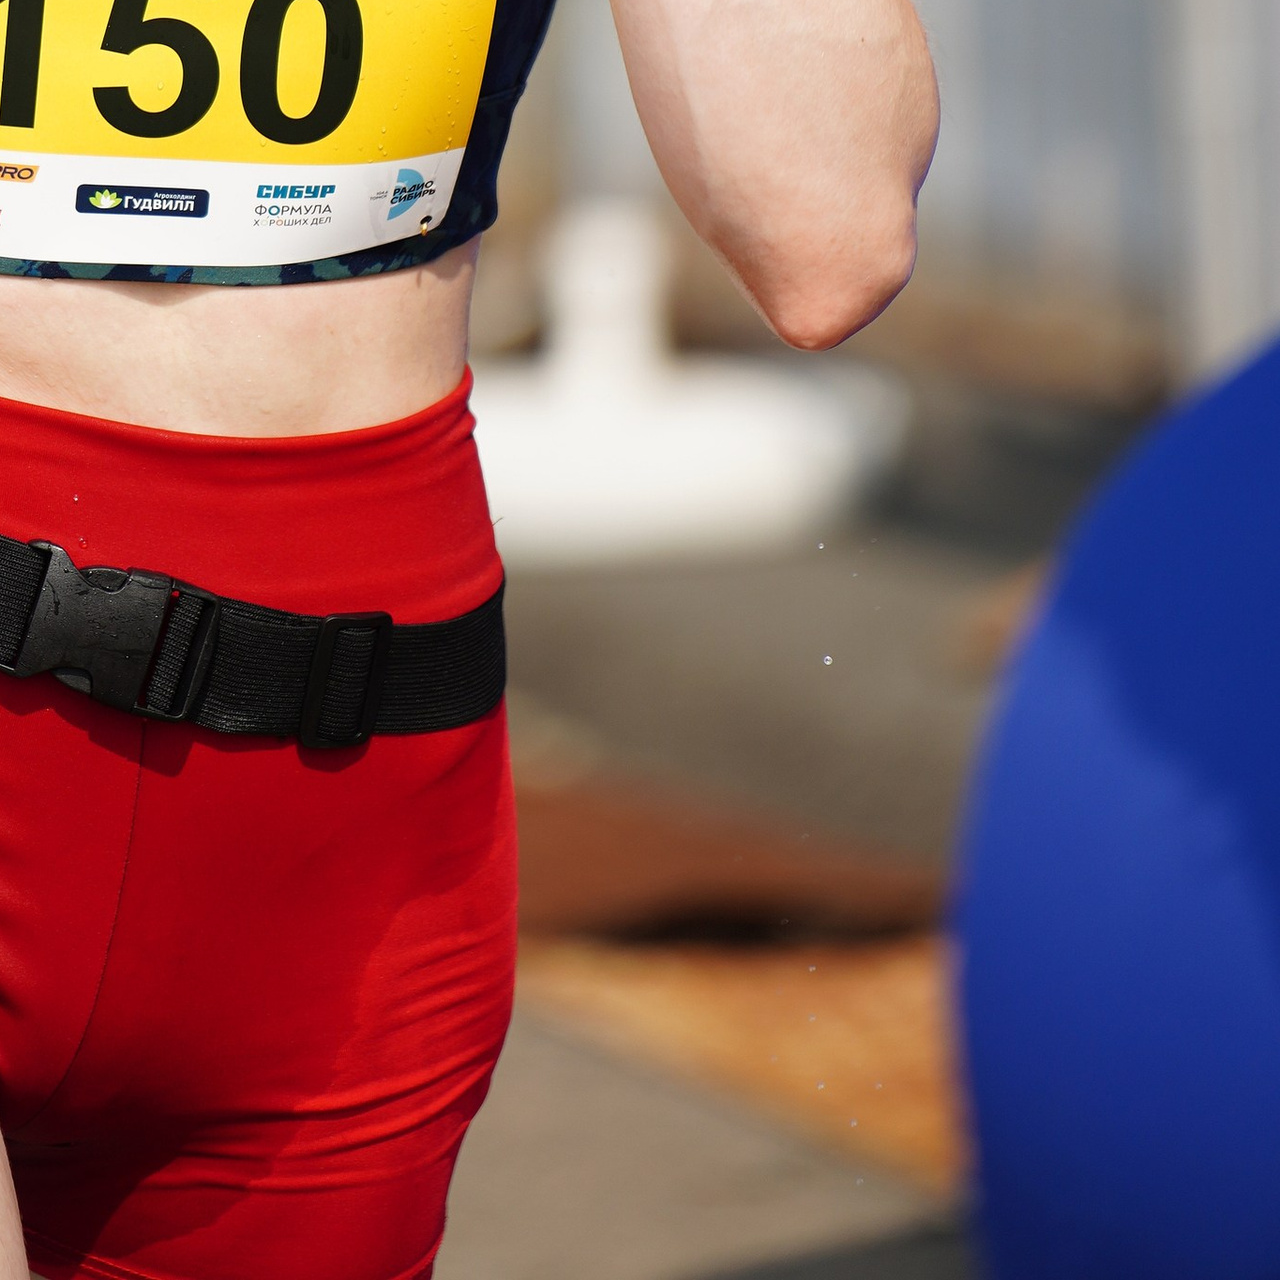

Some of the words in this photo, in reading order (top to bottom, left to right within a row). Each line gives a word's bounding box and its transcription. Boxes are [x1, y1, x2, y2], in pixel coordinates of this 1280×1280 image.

[256, 184, 336, 199] СИБУР
[393, 180, 434, 196] РАДИО
[390, 189, 436, 205] СИБИРЬ
[254, 204, 332, 216] ФОРМУЛА
[253, 218, 309, 227] ХОРОШИХ
[310, 216, 332, 226] ДЕЛ
